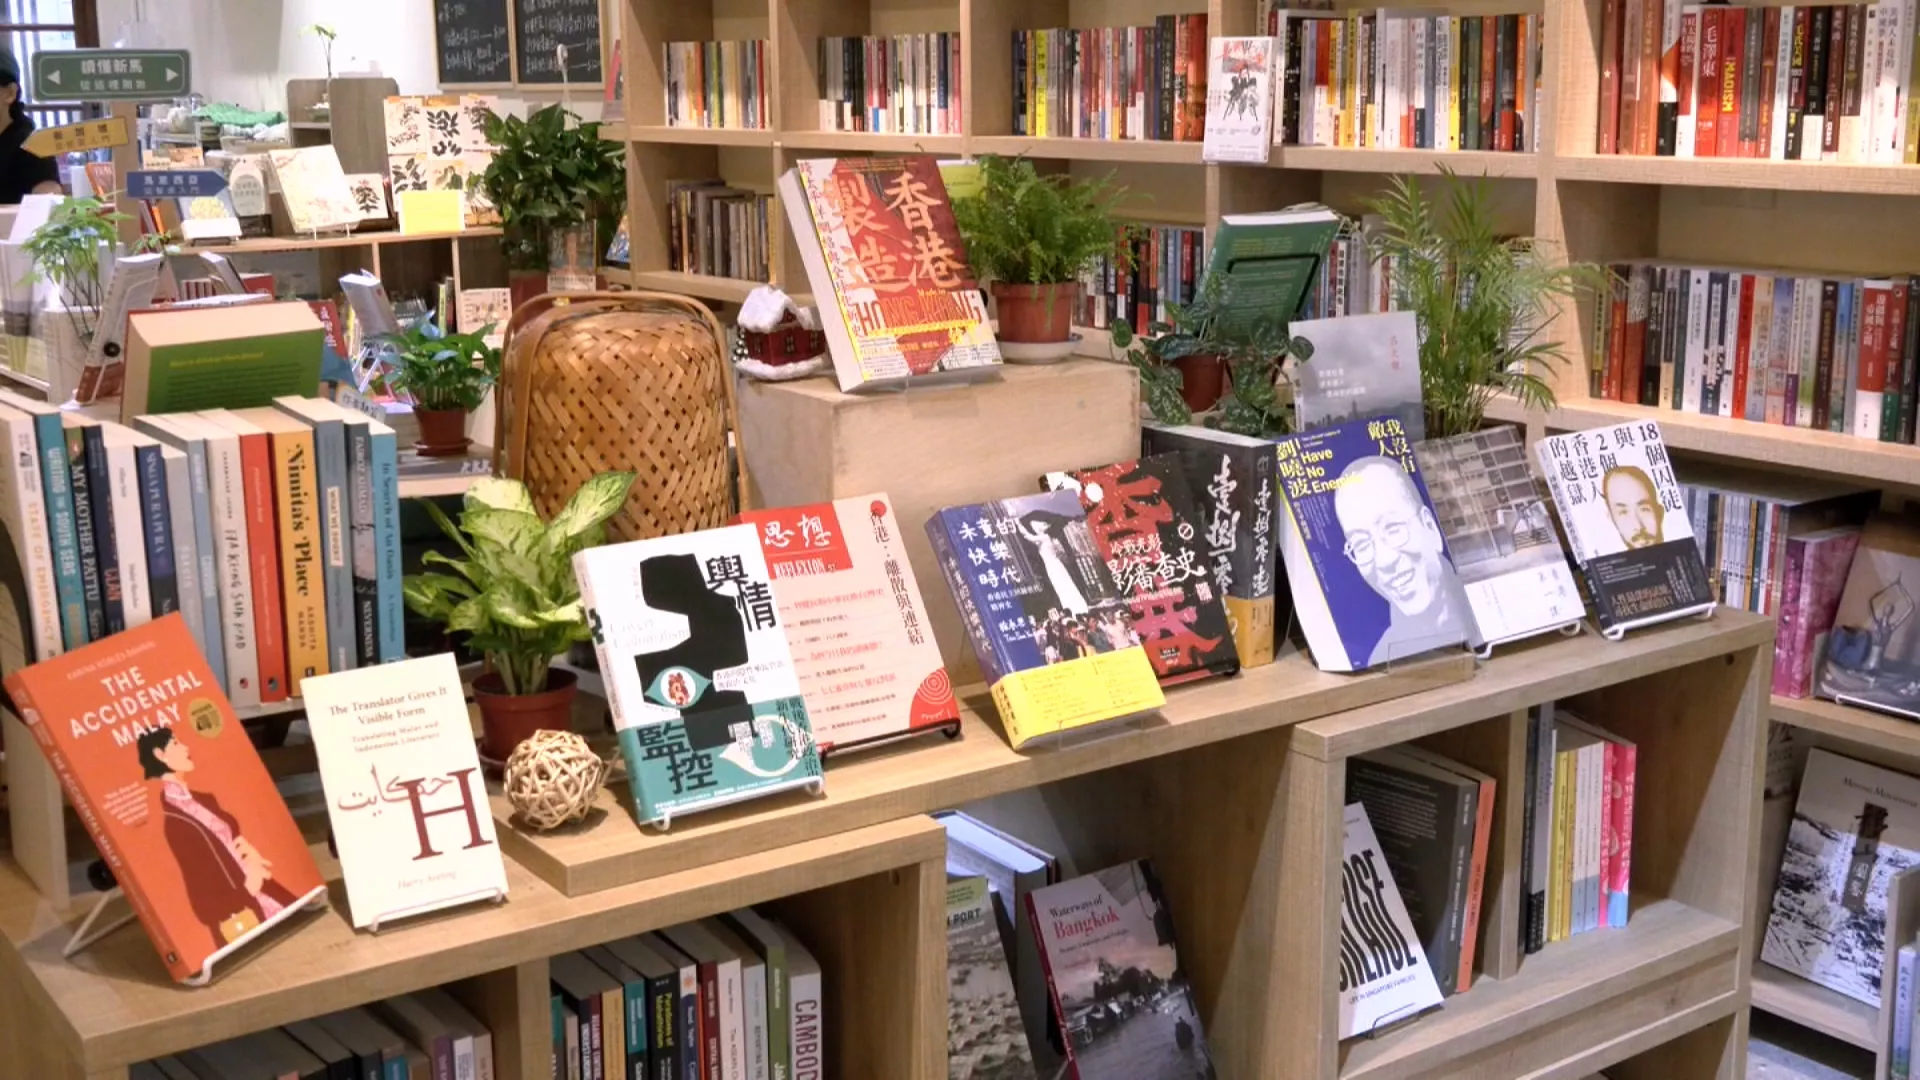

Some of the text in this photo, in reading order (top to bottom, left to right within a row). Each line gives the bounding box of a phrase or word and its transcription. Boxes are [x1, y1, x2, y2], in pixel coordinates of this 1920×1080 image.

[1703, 25, 1717, 77] 毛澤東
[1722, 63, 1736, 112] MAOISM
[823, 172, 916, 293] 製造
[884, 170, 968, 289] 香港
[1300, 448, 1333, 464] Have
[1367, 420, 1394, 457] 敵人
[1387, 418, 1416, 474] 我沒有
[1614, 426, 1636, 449] 與
[47, 447, 66, 493] WRITING
[72, 464, 85, 486] MY
[1276, 438, 1312, 499] 劉曉波
[1306, 465, 1325, 479] No
[1550, 438, 1588, 506] 的越獄
[384, 478, 393, 517] Search
[55, 511, 72, 546] SOUTH
[75, 488, 93, 552] MOTHER
[287, 443, 314, 598] Nimita's Place
[764, 514, 832, 548] 思想
[959, 517, 1017, 541] 未竟的
[59, 549, 76, 577] SEAS
[968, 540, 1012, 567] 快樂
[82, 556, 98, 602] PATTU
[104, 568, 121, 601] CLAN
[705, 554, 776, 632] 輿情
[978, 566, 1021, 588] 時代
[101, 665, 146, 697] THE
[70, 670, 203, 739] ACCIDENTAL
[330, 686, 447, 716] The Translator Gives It
[357, 706, 426, 725] Visible Form
[111, 703, 182, 747] MALAY
[636, 723, 717, 794] 監控
[65, 773, 102, 837] ACCIDENTAL
[99, 834, 122, 869] MALAY
[397, 767, 493, 860] H
[953, 908, 982, 927] PORT
[1049, 894, 1103, 918] Waterways of
[1053, 906, 1120, 939] Bangkok
